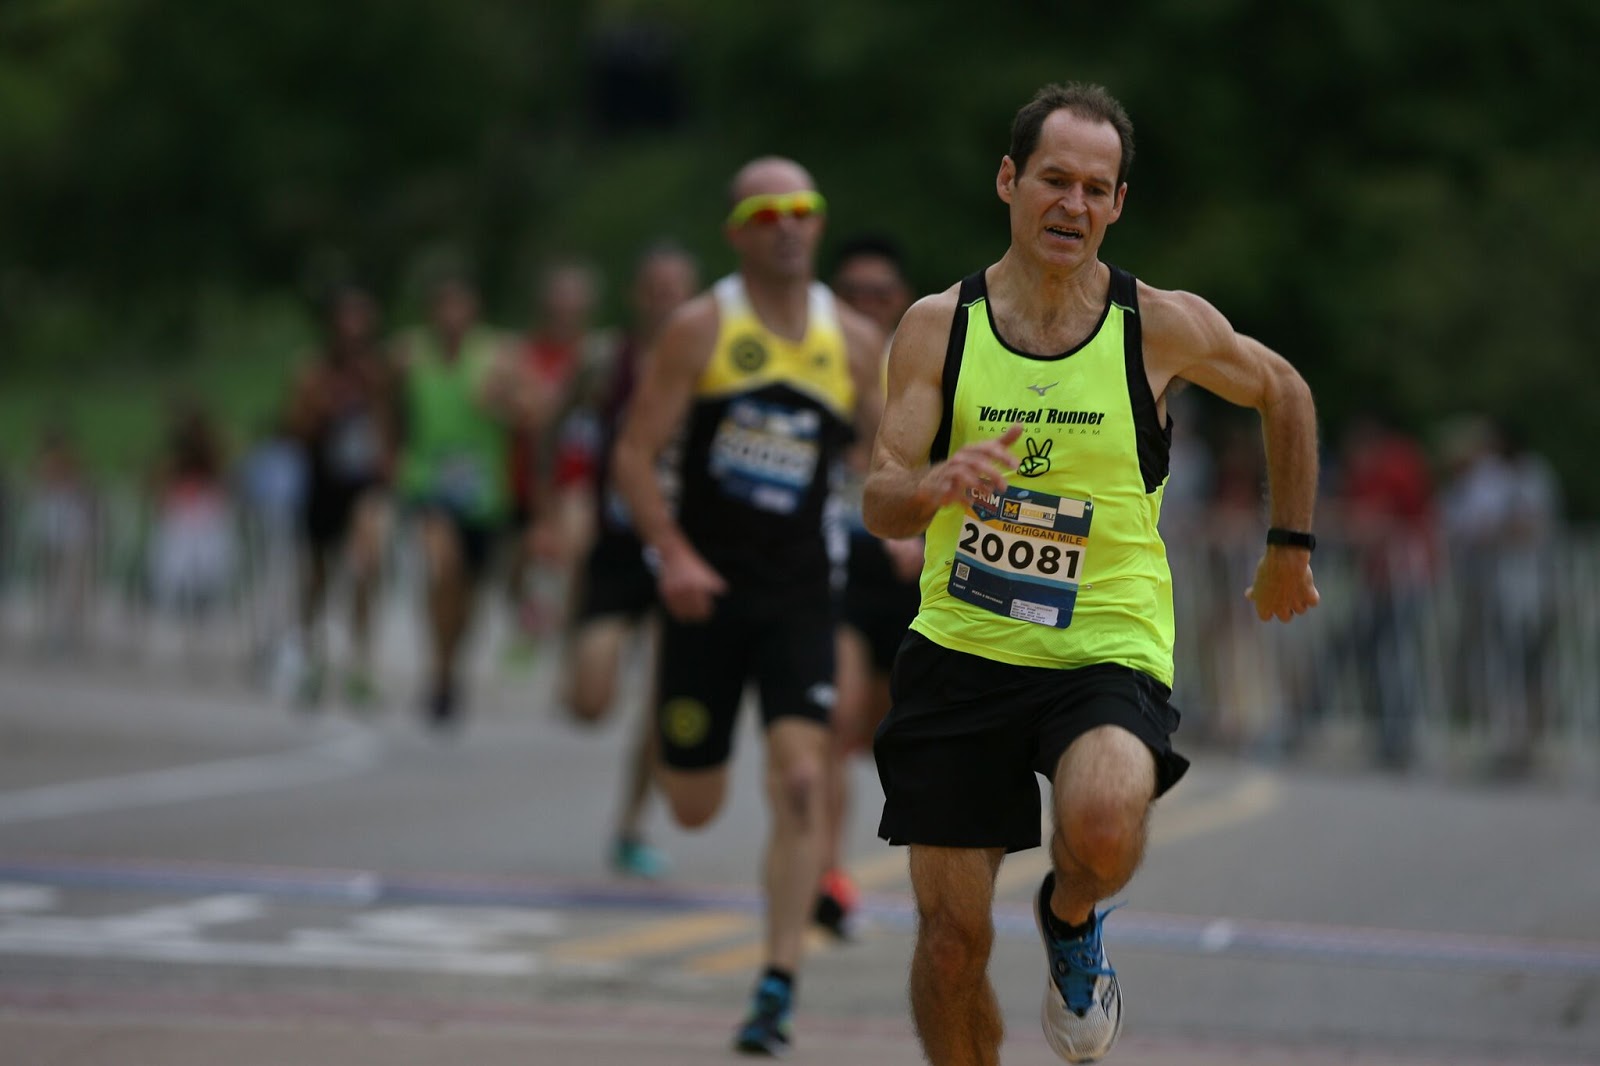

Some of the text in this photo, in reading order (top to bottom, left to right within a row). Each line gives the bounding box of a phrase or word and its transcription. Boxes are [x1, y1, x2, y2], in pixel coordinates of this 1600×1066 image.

[977, 406, 1104, 426] Vertical Runner
[978, 426, 1100, 436] RACNG TEAM
[1002, 523, 1083, 546] MICHIGAN MILE
[959, 523, 1080, 579] 20081
